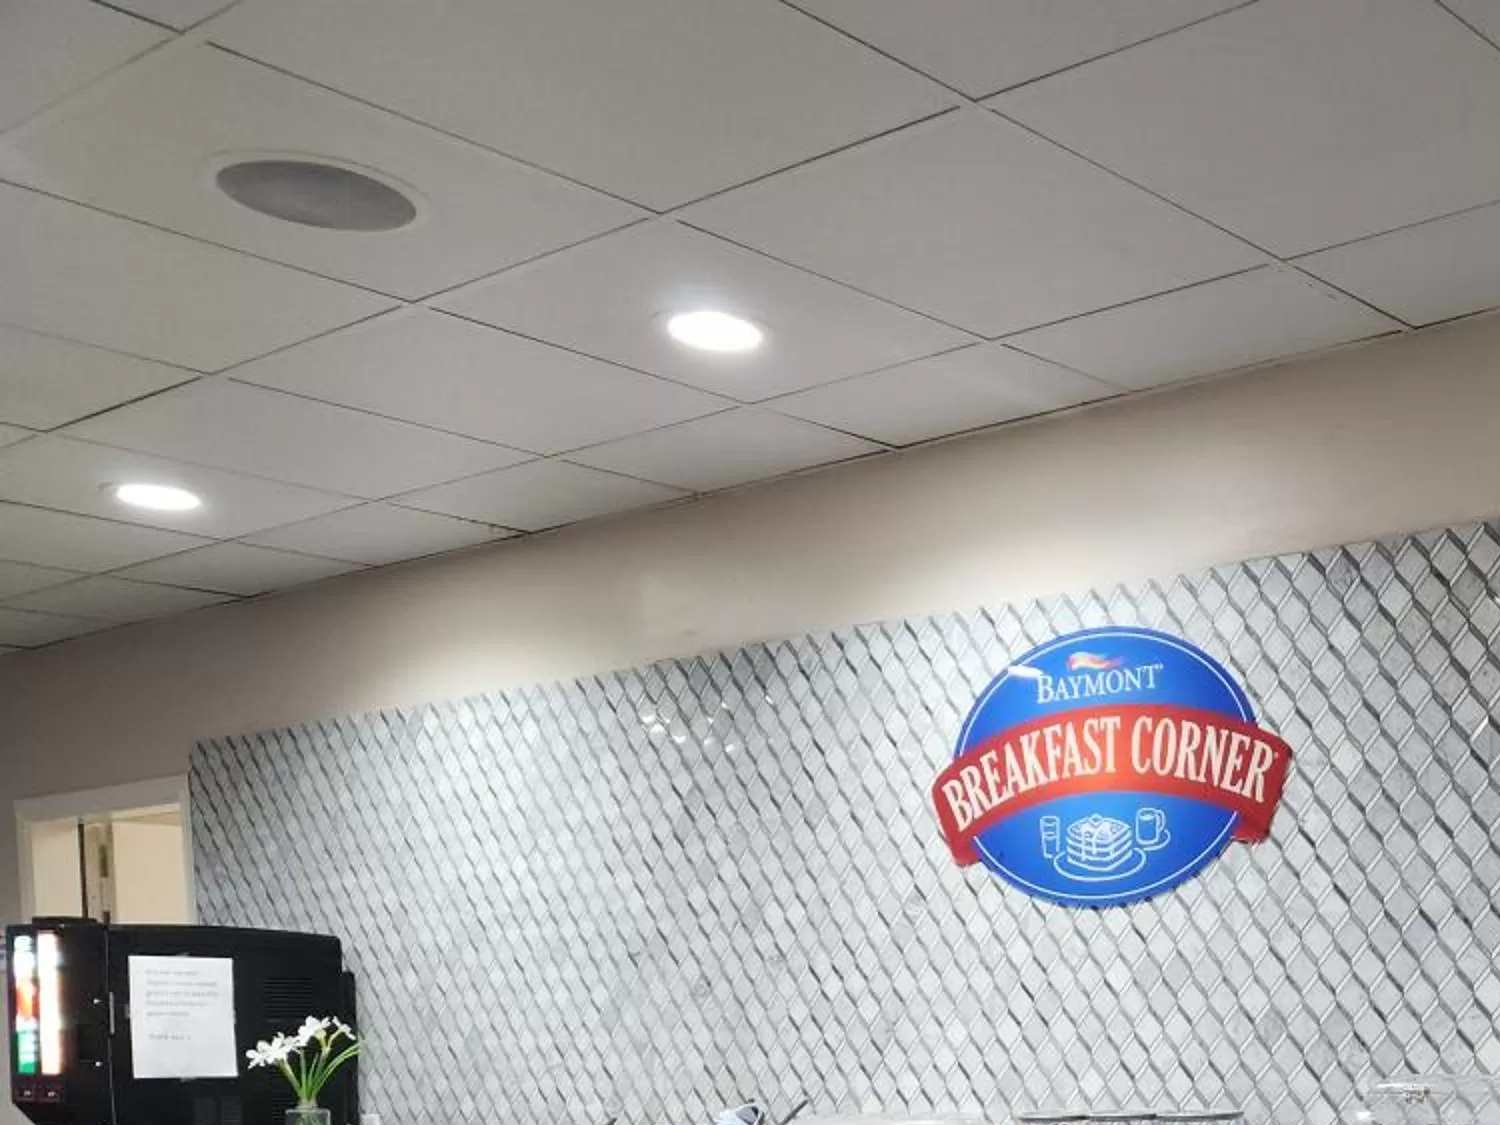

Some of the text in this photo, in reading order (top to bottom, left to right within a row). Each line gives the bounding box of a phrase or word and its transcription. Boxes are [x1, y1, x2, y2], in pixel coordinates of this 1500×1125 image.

[1037, 664, 1158, 704] BAYMONT
[942, 715, 1274, 833] BREAKFAST CORNER
